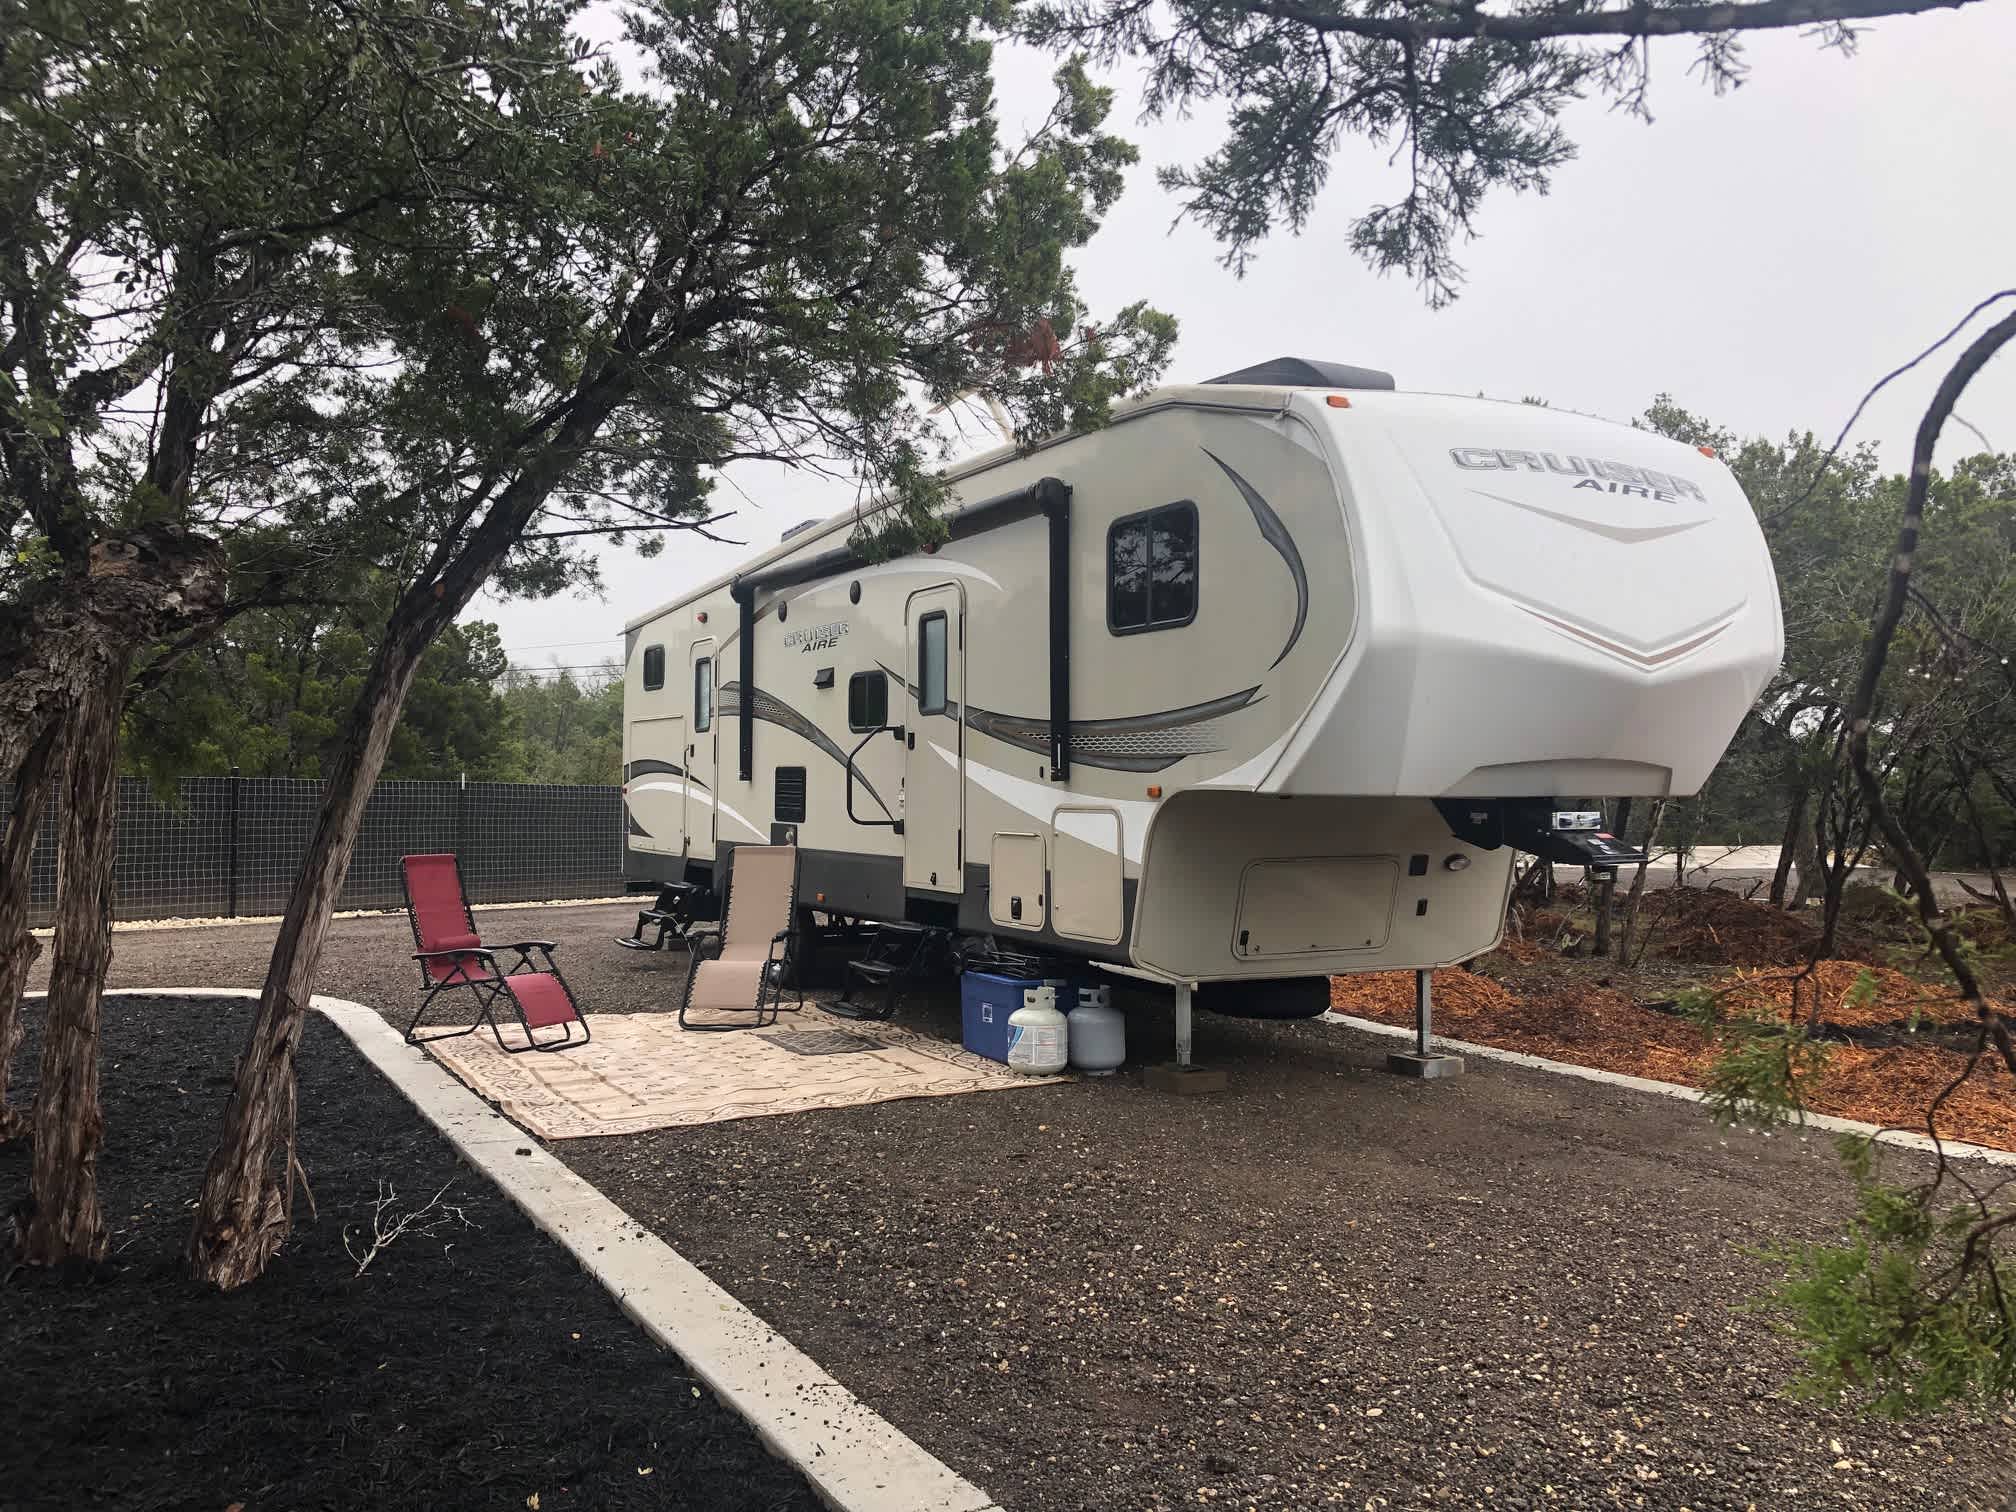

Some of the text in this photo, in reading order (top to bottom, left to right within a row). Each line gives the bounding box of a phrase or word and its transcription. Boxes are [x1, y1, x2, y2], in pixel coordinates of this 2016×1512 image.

[1449, 447, 1707, 504] CRUISER
[1573, 479, 1678, 504] AIRE
[783, 622, 849, 648] CRUISER
[801, 637, 838, 653] AIRE
